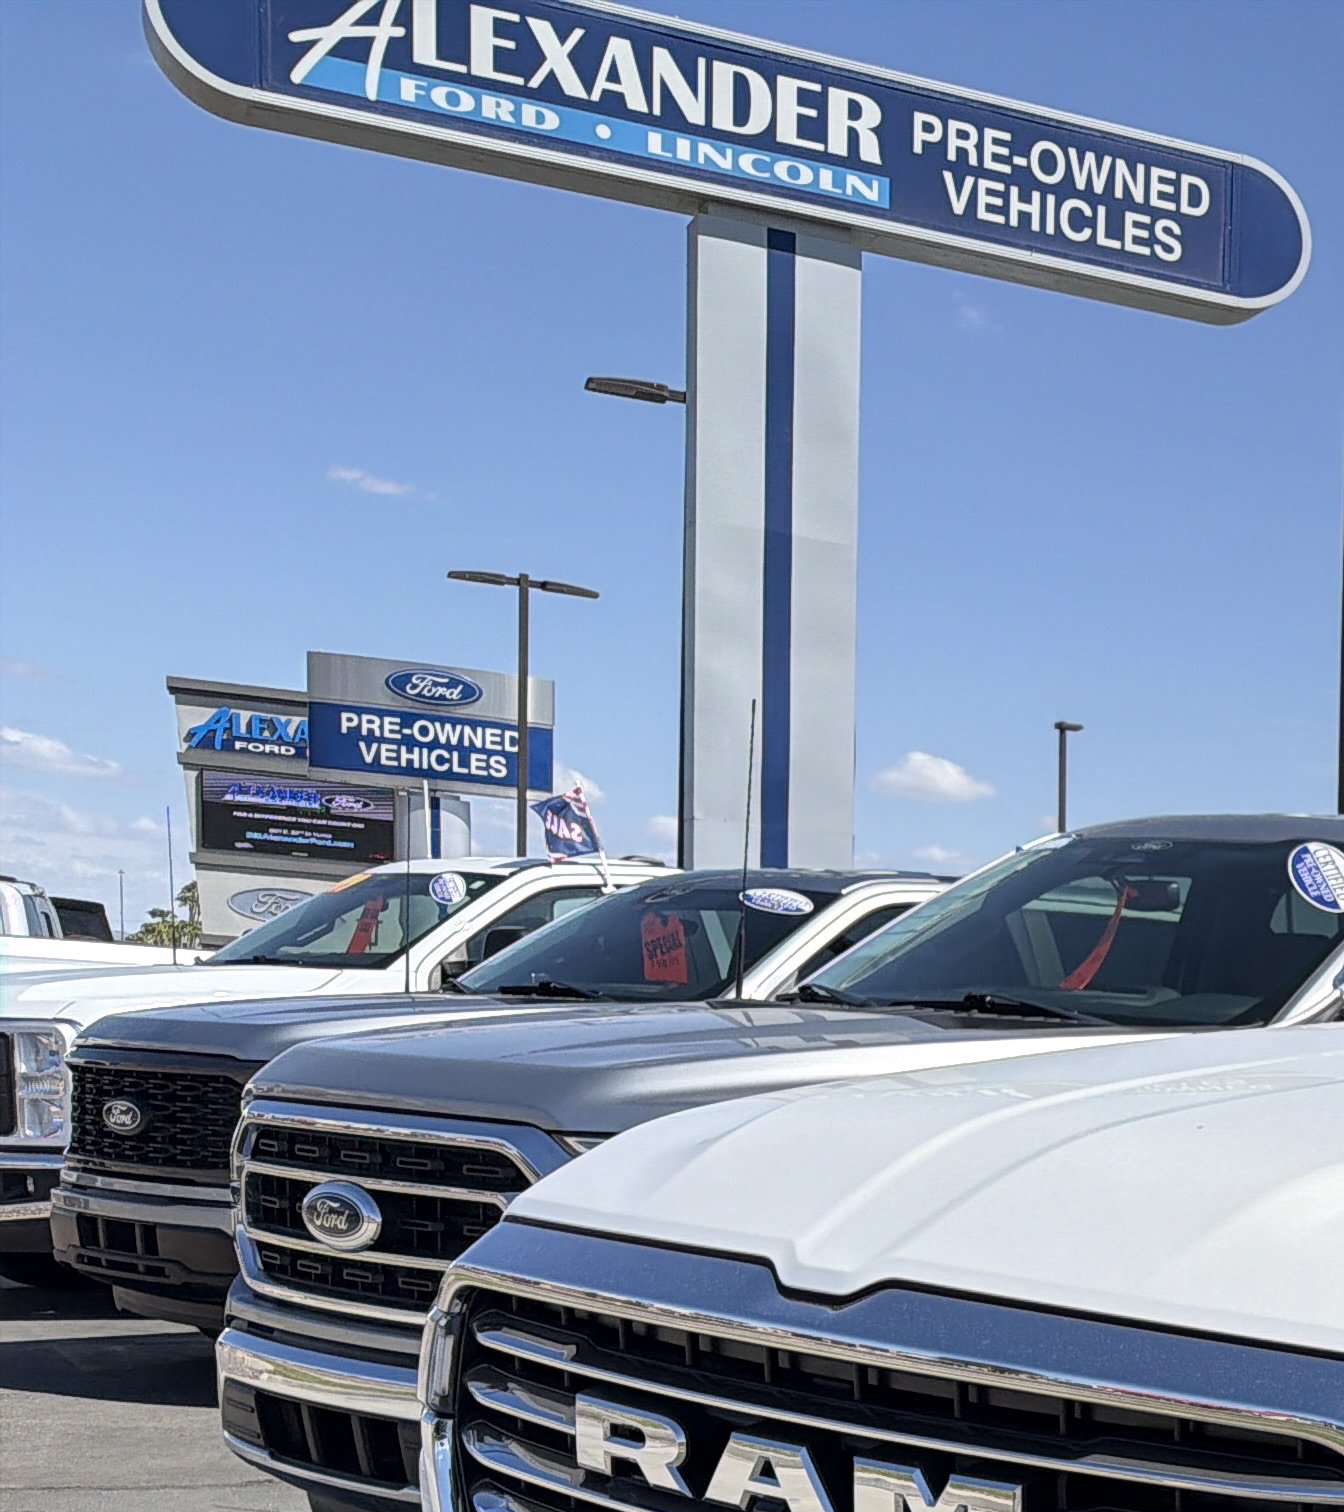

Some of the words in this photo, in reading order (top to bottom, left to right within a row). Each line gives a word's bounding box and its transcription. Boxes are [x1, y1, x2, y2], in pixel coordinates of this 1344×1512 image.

[288, 0, 882, 165] ALEXANDER
[399, 76, 560, 132] FORD
[646, 131, 890, 202] LINCOLN
[912, 111, 1210, 217] PRE-OWNED
[942, 170, 1183, 262] VEHICLES
[406, 673, 463, 700] Ford
[234, 741, 296, 756] FORD
[340, 712, 518, 752] PRE-OWNED
[358, 741, 508, 778] VEHICLES
[109, 1104, 133, 1125] Ford
[313, 1198, 349, 1231] Ford
